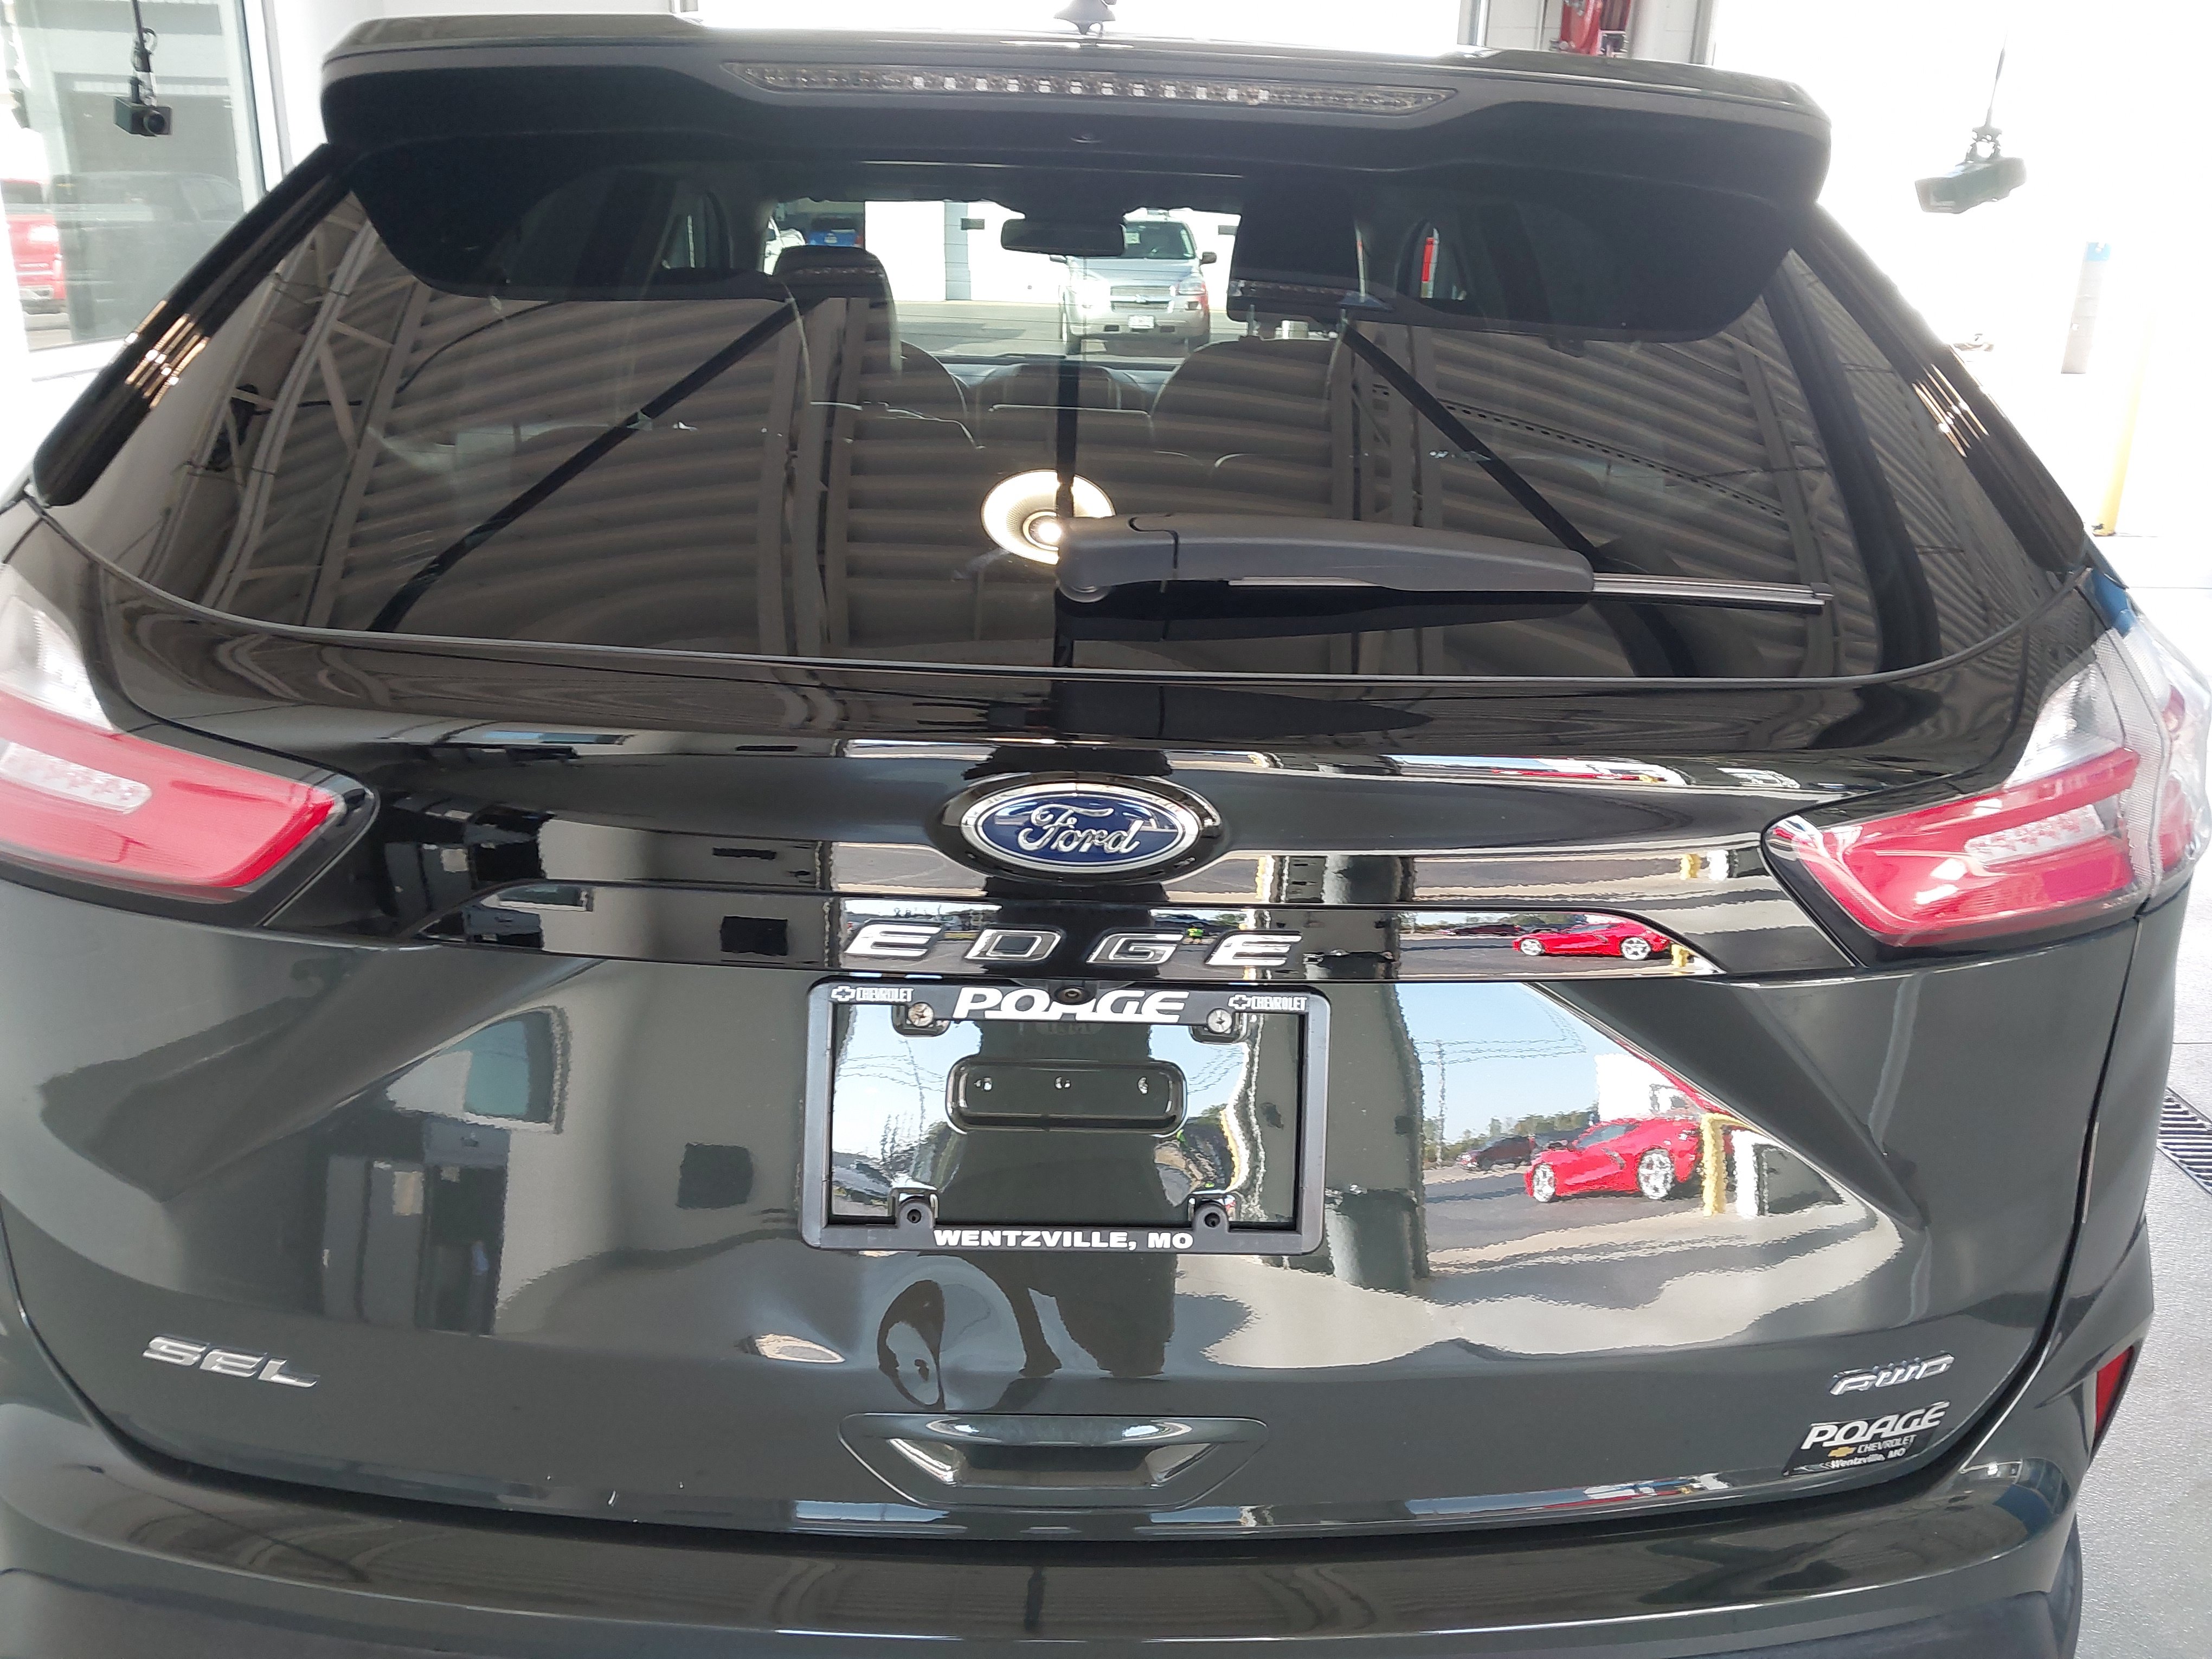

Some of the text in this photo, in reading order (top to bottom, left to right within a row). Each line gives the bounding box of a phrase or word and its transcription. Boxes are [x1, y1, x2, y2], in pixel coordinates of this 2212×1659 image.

[1018, 803, 1144, 853] Ford
[844, 923, 1302, 966] EDGE
[856, 987, 914, 1001] CHEVROLET
[1251, 996, 1307, 1011] CHEVROLET
[934, 1230, 1193, 1250] WENTZVILLE, MO
[143, 1336, 317, 1388] SEL
[1801, 1400, 1950, 1450] POAGE
[1857, 1435, 1917, 1453] CHEVROLET
